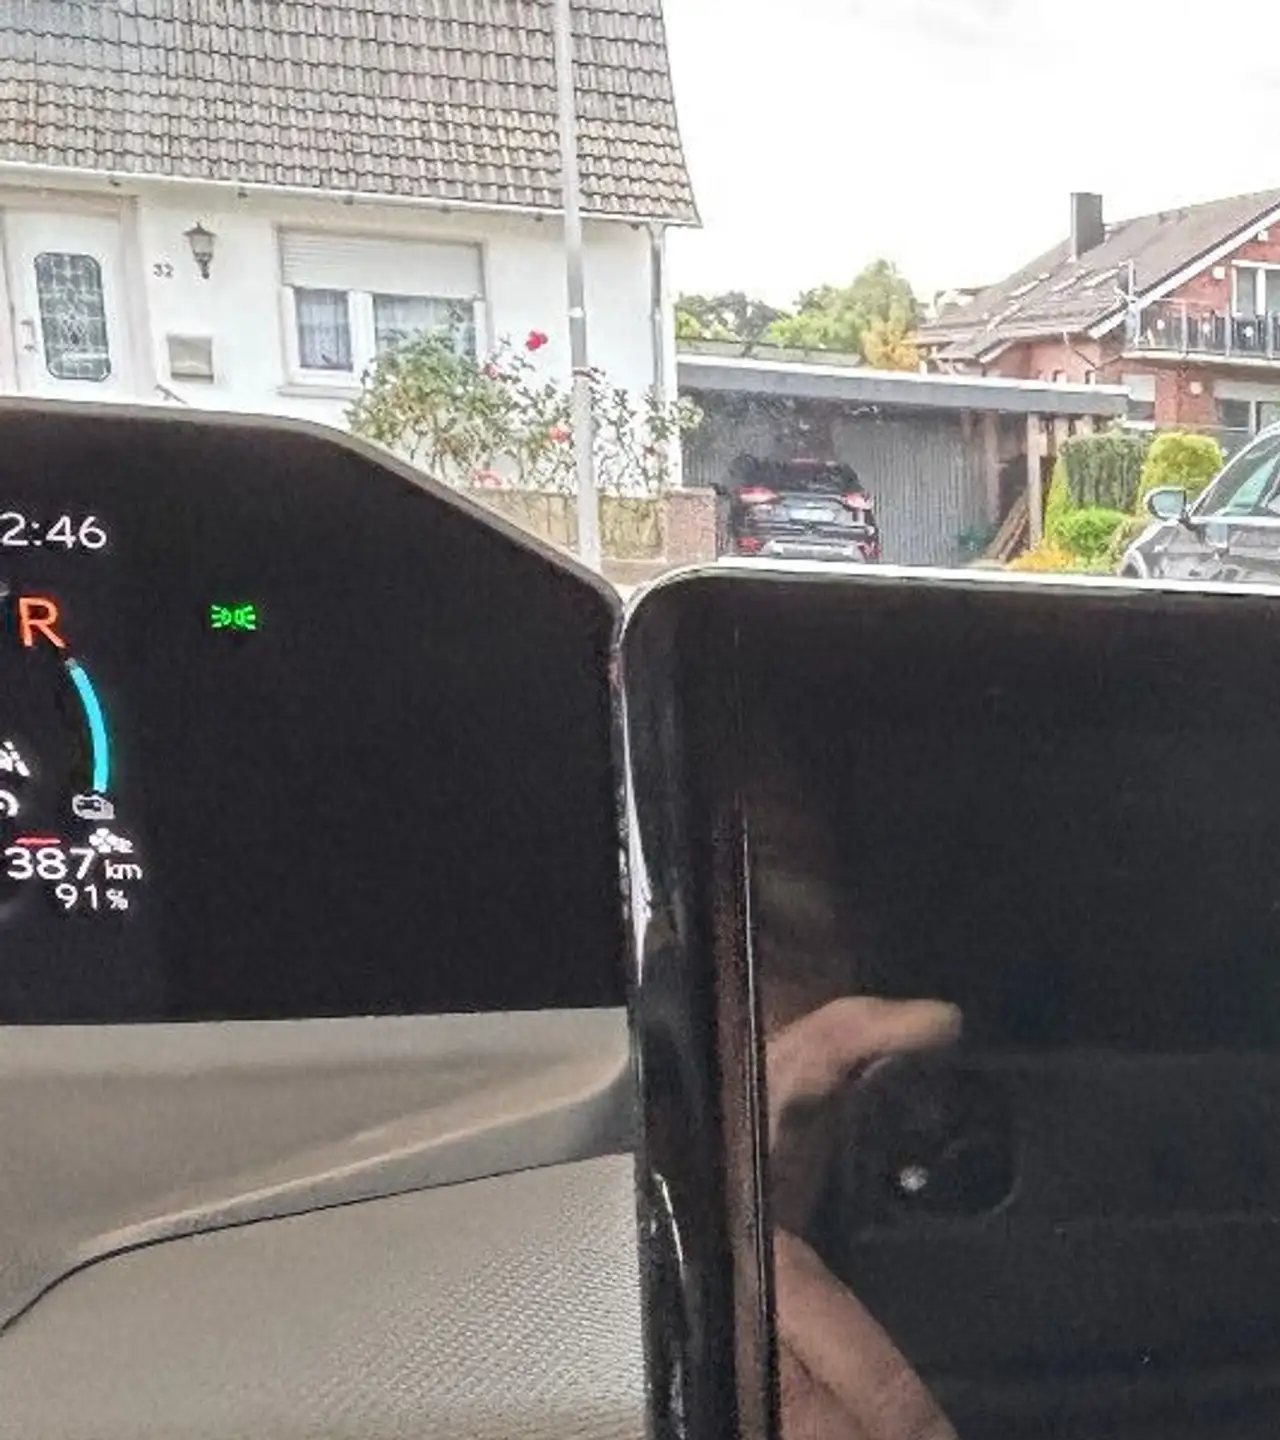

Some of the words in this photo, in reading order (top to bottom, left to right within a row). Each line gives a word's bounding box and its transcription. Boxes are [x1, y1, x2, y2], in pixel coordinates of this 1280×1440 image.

[19, 597, 68, 648] R
[4, 846, 96, 880] 387
[105, 858, 143, 880] km
